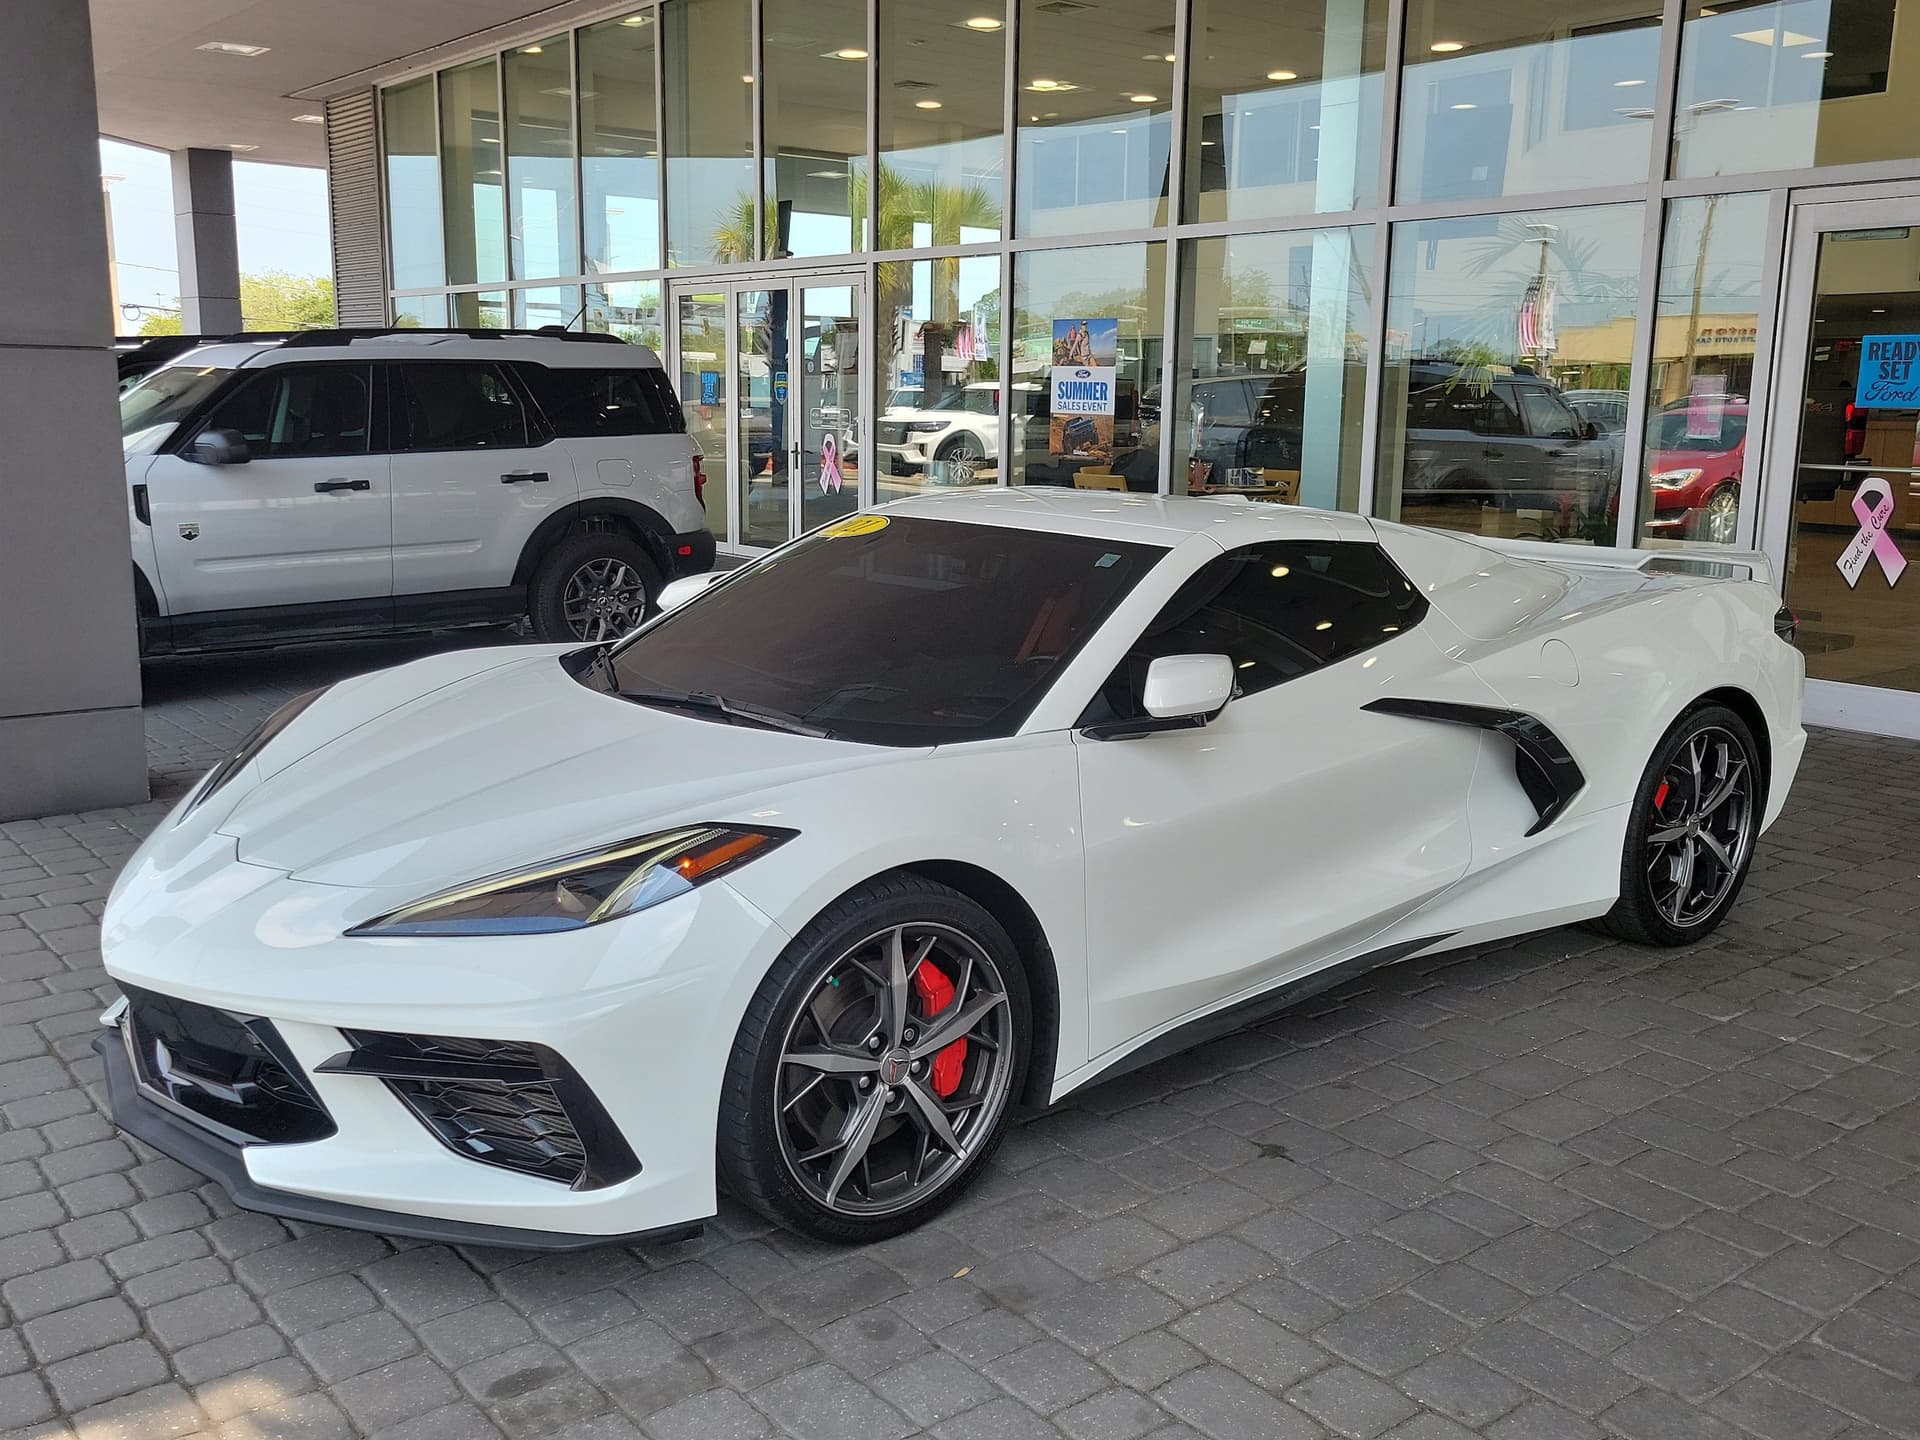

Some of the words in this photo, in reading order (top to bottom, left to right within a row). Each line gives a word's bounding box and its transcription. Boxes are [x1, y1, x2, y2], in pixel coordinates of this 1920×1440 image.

[1868, 341, 1920, 361] READ
[1879, 360, 1913, 380] SET
[1057, 381, 1108, 401] SUMMER
[1865, 380, 1920, 402] Ford
[1057, 400, 1081, 411] SALES
[1082, 401, 1108, 412] EVENT
[1843, 546, 1863, 574] Find
[1861, 531, 1874, 547] the
[1870, 504, 1889, 530] Cure
